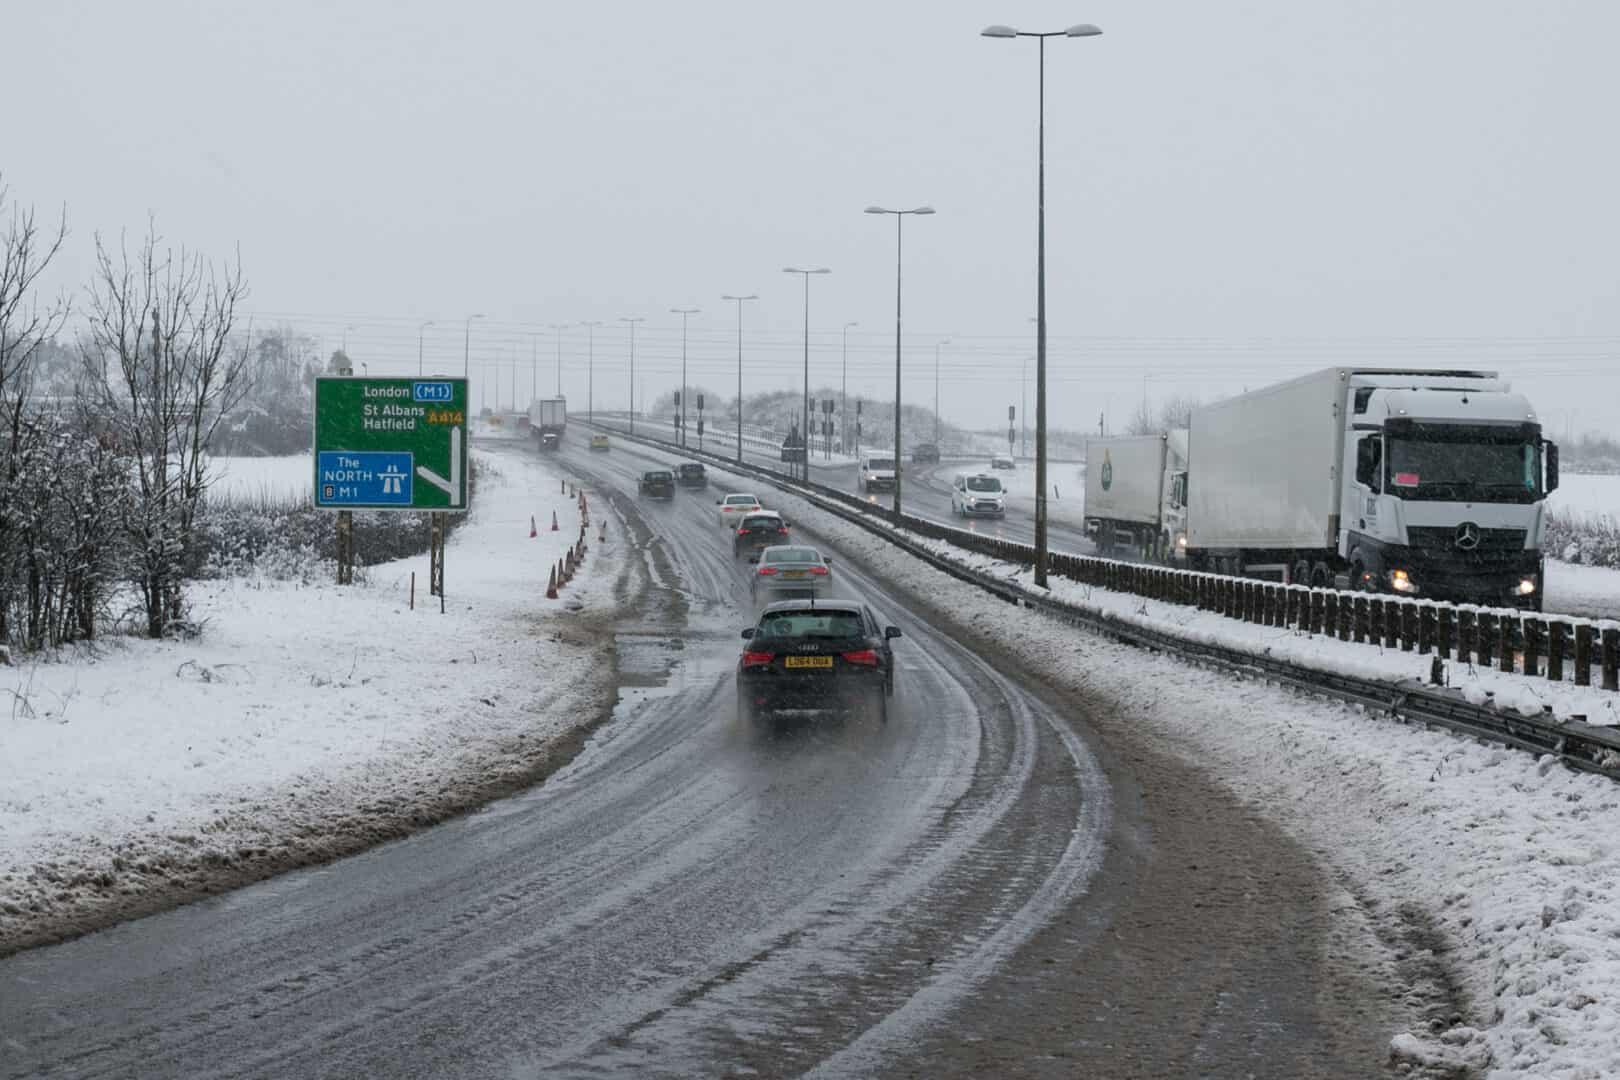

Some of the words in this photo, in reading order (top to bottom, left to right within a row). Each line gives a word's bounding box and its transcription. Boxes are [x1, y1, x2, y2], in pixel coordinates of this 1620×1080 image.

[364, 386, 410, 397] London
[415, 385, 450, 398] (M1)
[363, 404, 378, 416] St
[382, 404, 425, 416] Albans
[363, 418, 416, 430] Hatfield
[428, 412, 463, 424] A414
[337, 457, 360, 469] The
[324, 471, 372, 481] NORTH
[339, 487, 358, 497] M1
